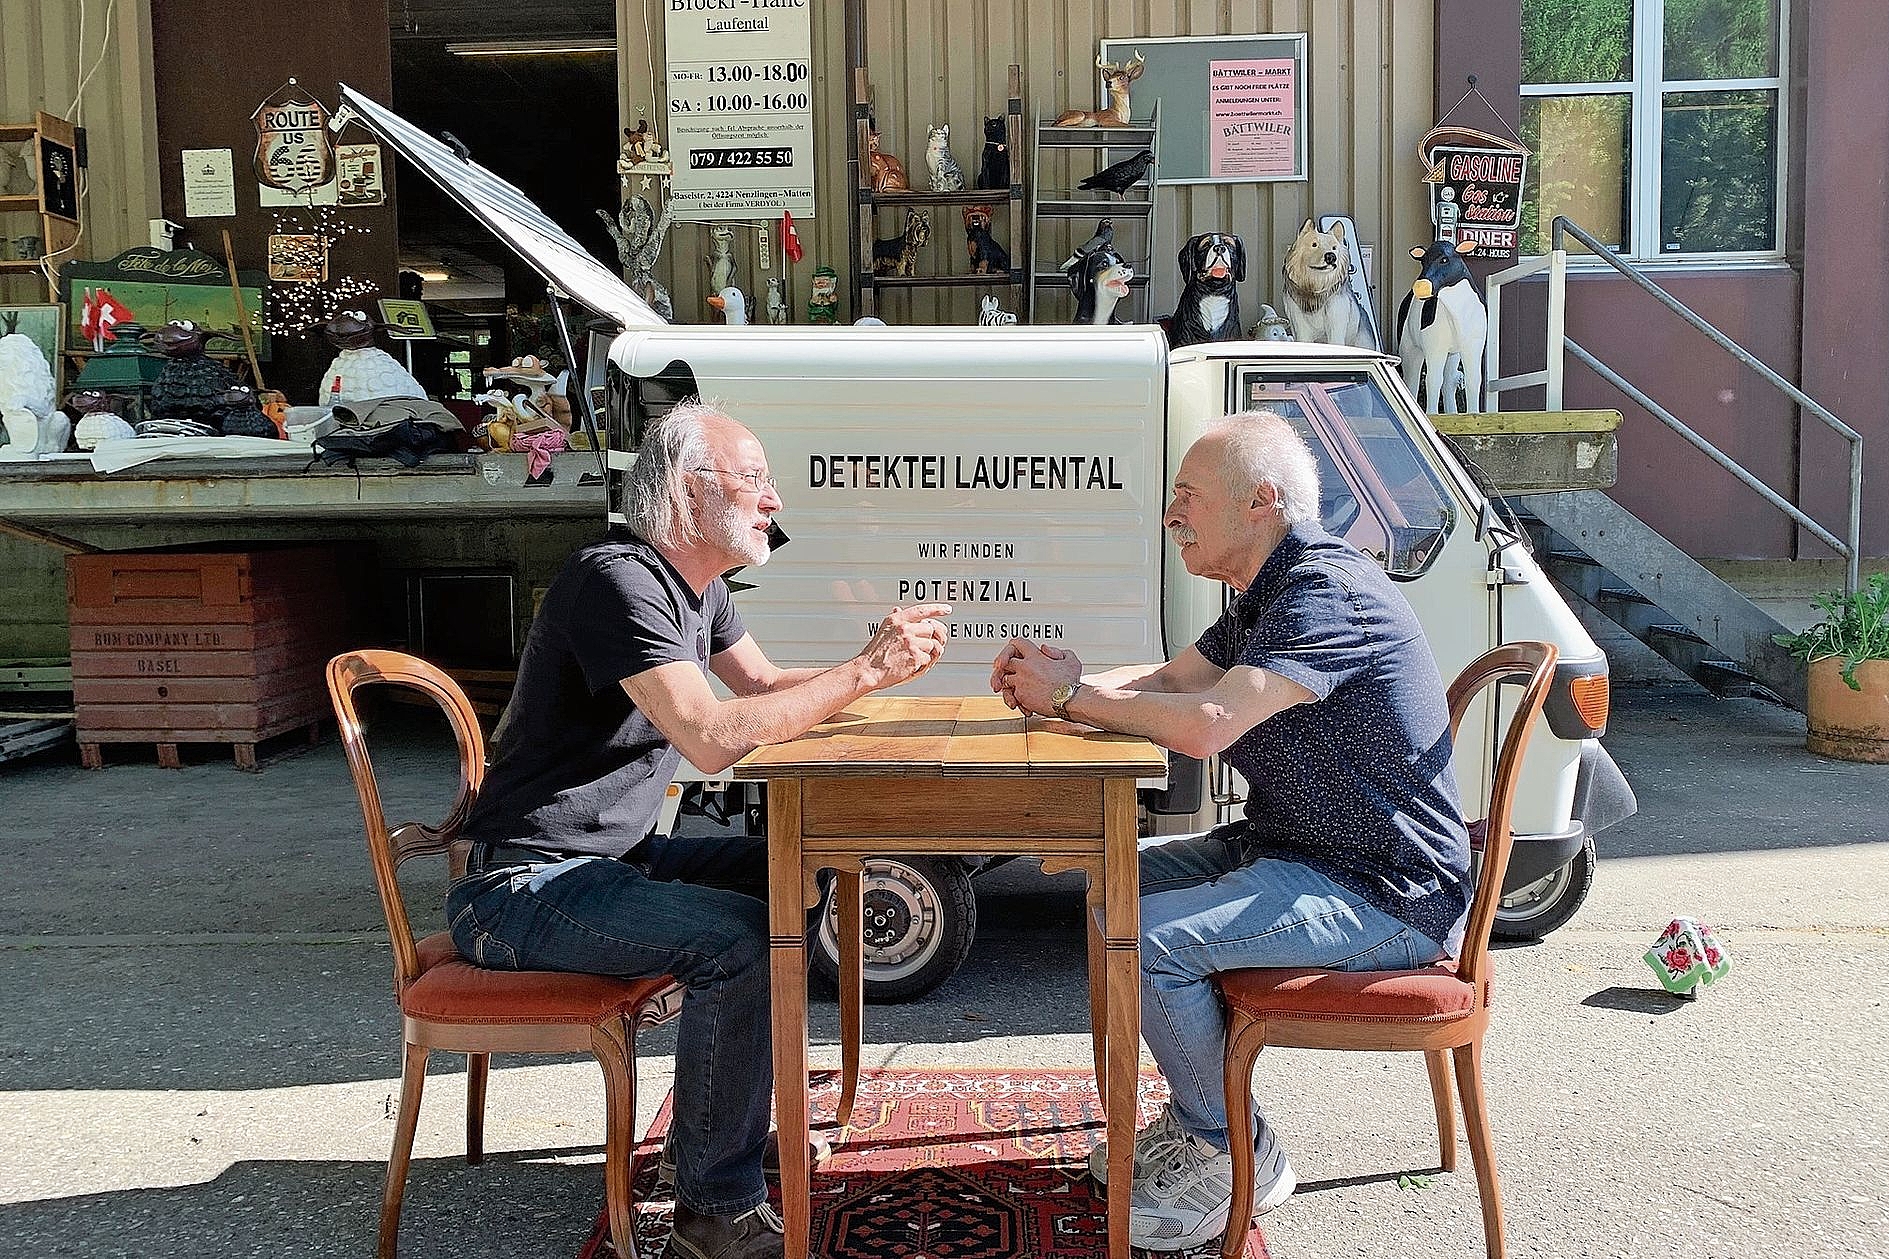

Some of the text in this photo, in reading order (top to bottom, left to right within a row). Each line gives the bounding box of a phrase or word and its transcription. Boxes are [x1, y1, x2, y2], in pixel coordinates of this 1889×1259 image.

[706, 17, 769, 31] Laufental
[1264, 68, 1292, 76] MARKT
[265, 110, 320, 128] ROUTE
[1223, 122, 1291, 137] BÄTTWILER
[283, 133, 304, 145] US
[690, 152, 715, 166] 079
[727, 152, 752, 165] 422
[755, 151, 772, 164] 55
[776, 150, 792, 164] 50
[1451, 155, 1521, 183] GASOLINE
[674, 191, 705, 200] Baselstr.
[716, 191, 734, 199] 4224
[1461, 183, 1489, 204] Gas
[745, 200, 781, 208] VERDYOL
[1464, 204, 1515, 222] Station
[1463, 230, 1513, 247] DINER
[1477, 248, 1487, 257] 24
[1489, 249, 1511, 258] HOURS
[154, 258, 171, 272] de
[173, 257, 187, 271] la
[809, 454, 1124, 490] DETEKTEI LAUFENTAL
[918, 543, 1014, 559] WIR FINDEN
[899, 580, 1033, 602] POTENZIAL
[963, 623, 995, 638] NUR
[1000, 623, 1065, 639] SUCHEN
[127, 632, 189, 646] COMPANY
[138, 659, 181, 673] BASEL
